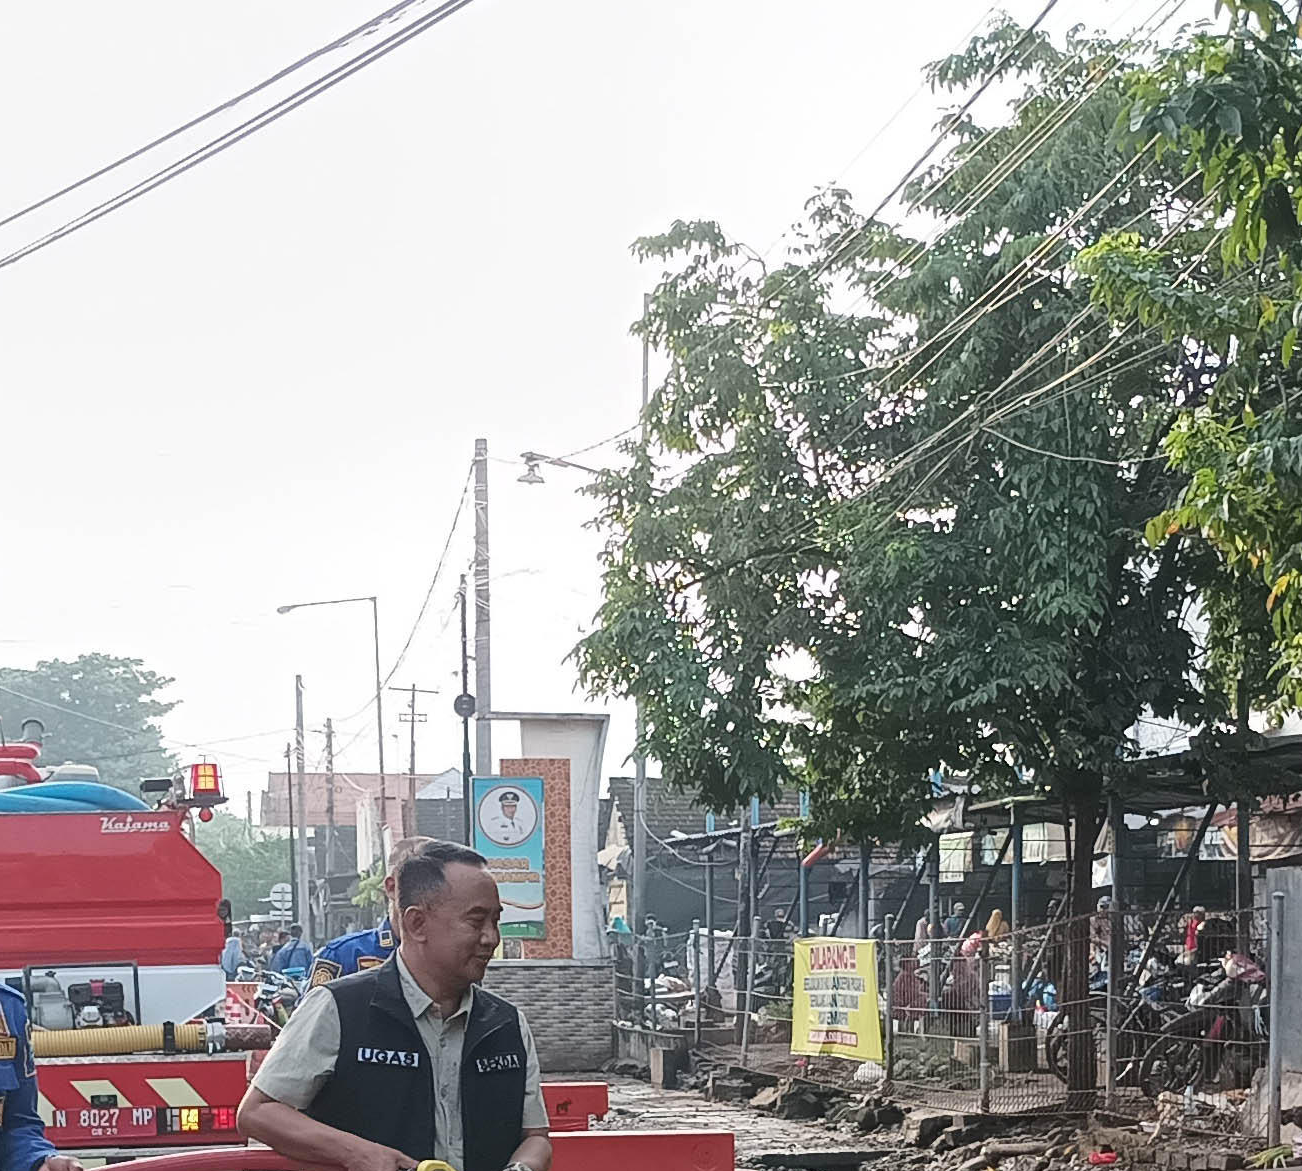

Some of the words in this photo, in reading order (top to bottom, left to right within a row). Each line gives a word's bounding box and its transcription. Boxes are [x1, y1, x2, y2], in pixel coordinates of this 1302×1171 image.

[56, 1110, 67, 1128] N
[80, 1109, 120, 1127] 8027
[132, 1108, 153, 1125] MP
